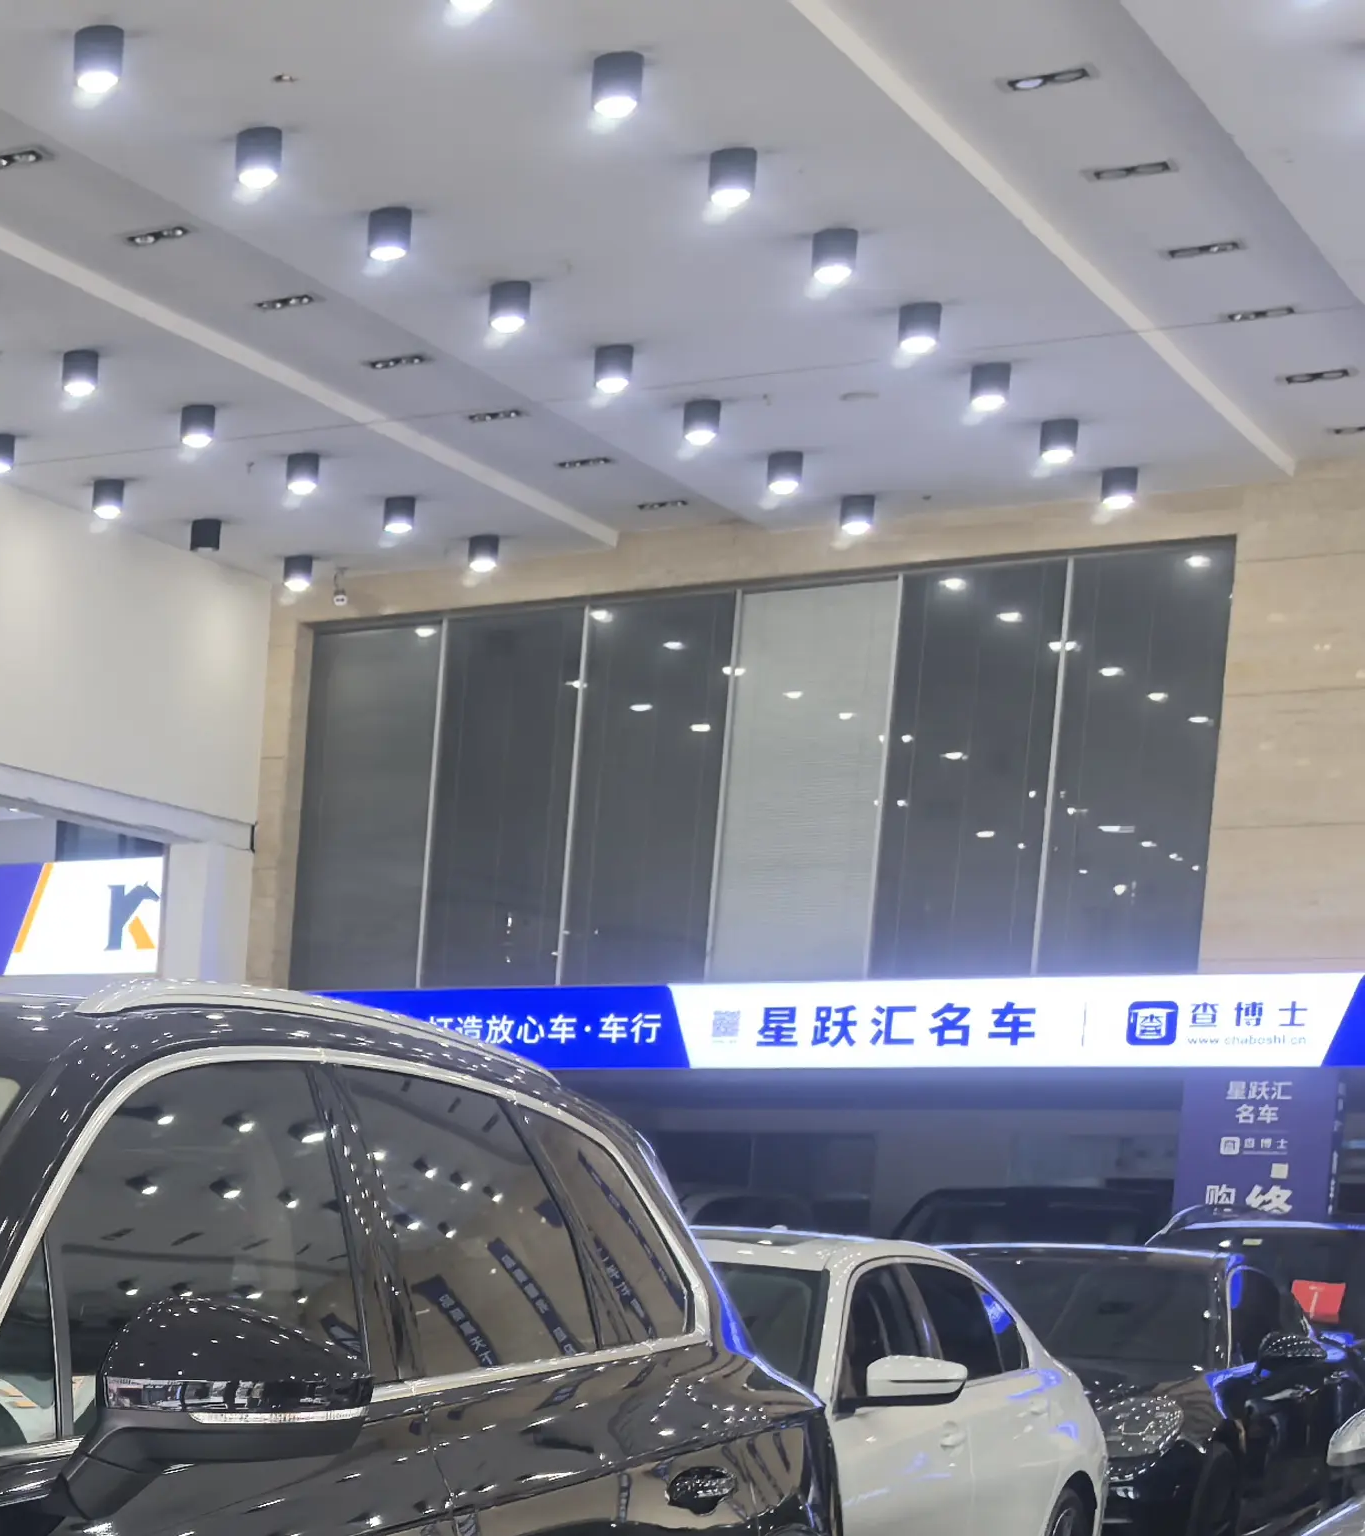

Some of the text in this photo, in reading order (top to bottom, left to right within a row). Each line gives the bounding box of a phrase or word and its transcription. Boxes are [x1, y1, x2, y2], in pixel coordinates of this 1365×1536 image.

[756, 1001, 1036, 1047] 星跃汇名车
[1189, 1001, 1308, 1028] 查博士
[1225, 1080, 1293, 1101] 星跃汇
[1235, 1104, 1279, 1125] 名车
